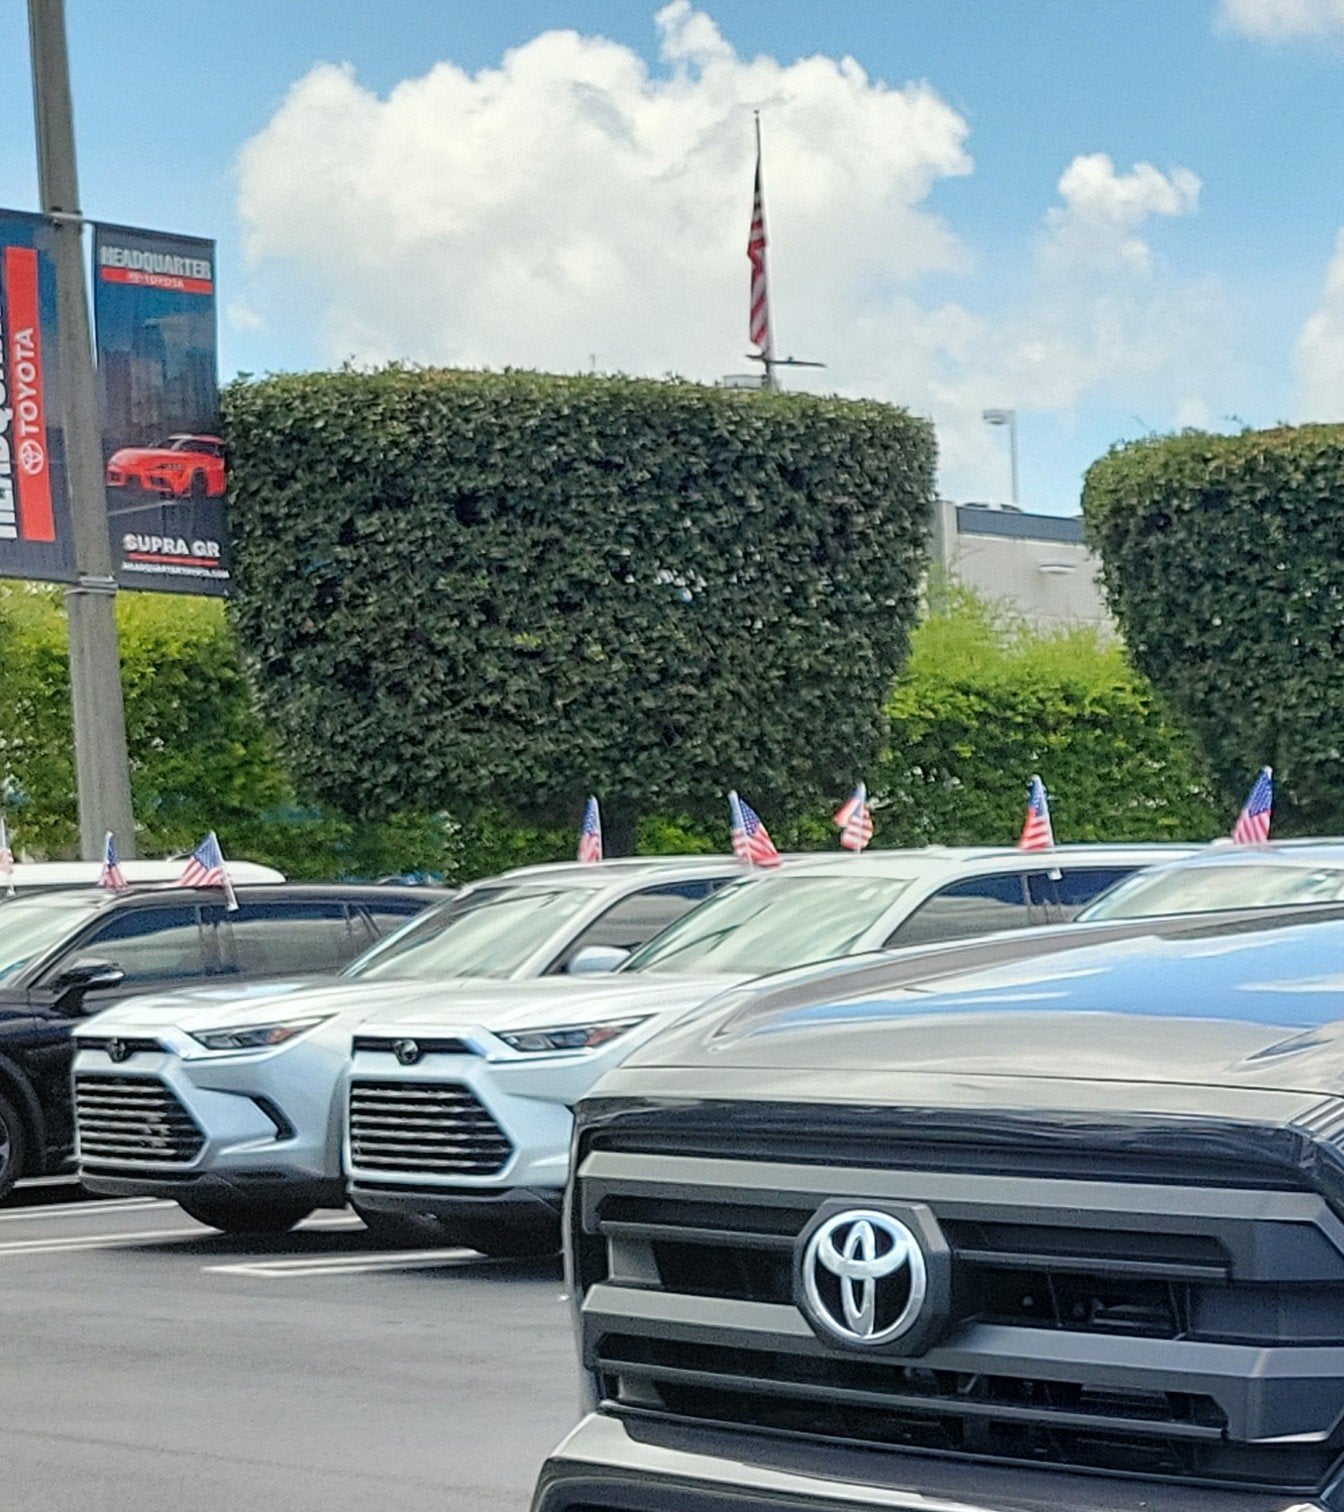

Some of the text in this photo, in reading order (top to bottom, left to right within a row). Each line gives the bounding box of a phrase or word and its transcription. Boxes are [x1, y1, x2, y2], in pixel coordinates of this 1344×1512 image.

[101, 246, 212, 280] HEADQUARTER
[15, 327, 40, 437] TOYOTA
[123, 533, 221, 558] SUPRA GR
